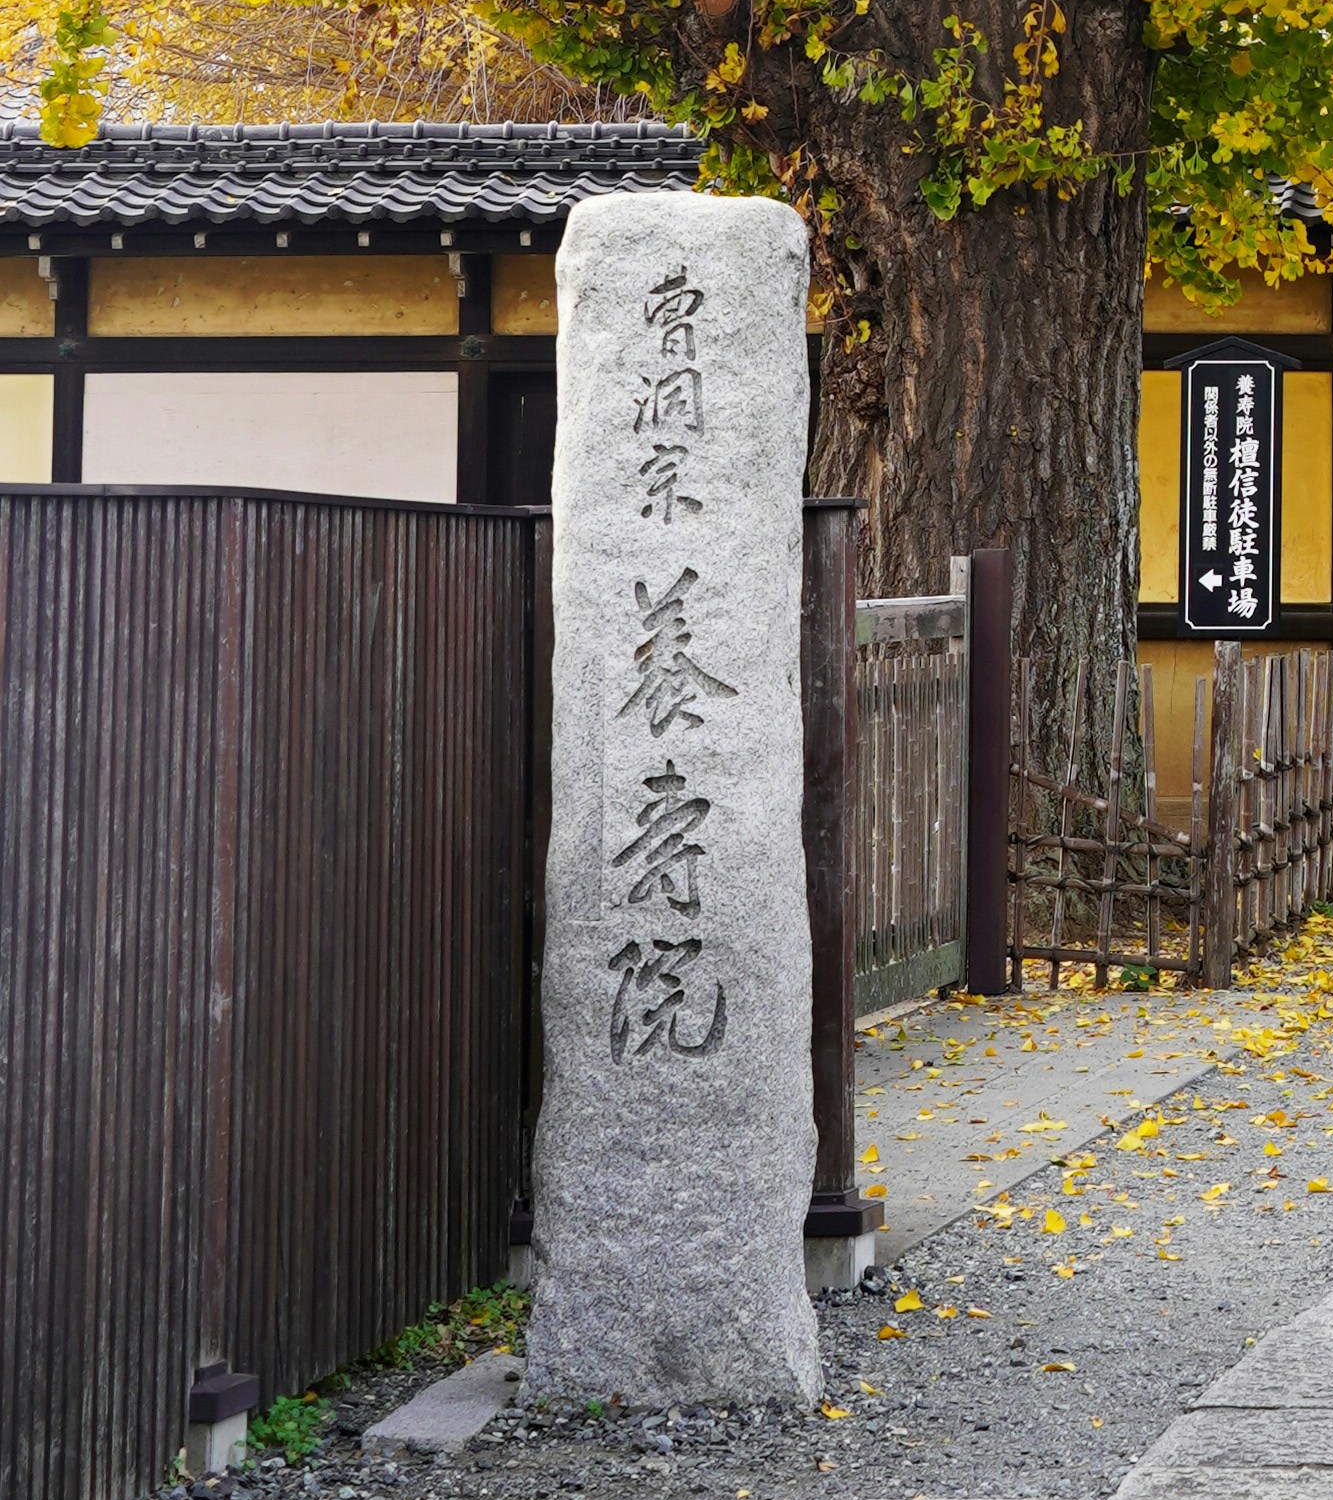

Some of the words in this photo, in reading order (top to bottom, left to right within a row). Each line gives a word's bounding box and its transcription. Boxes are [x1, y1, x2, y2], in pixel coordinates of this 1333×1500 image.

[1202, 386, 1219, 551] 関係者以外の無断駐車厳禁
